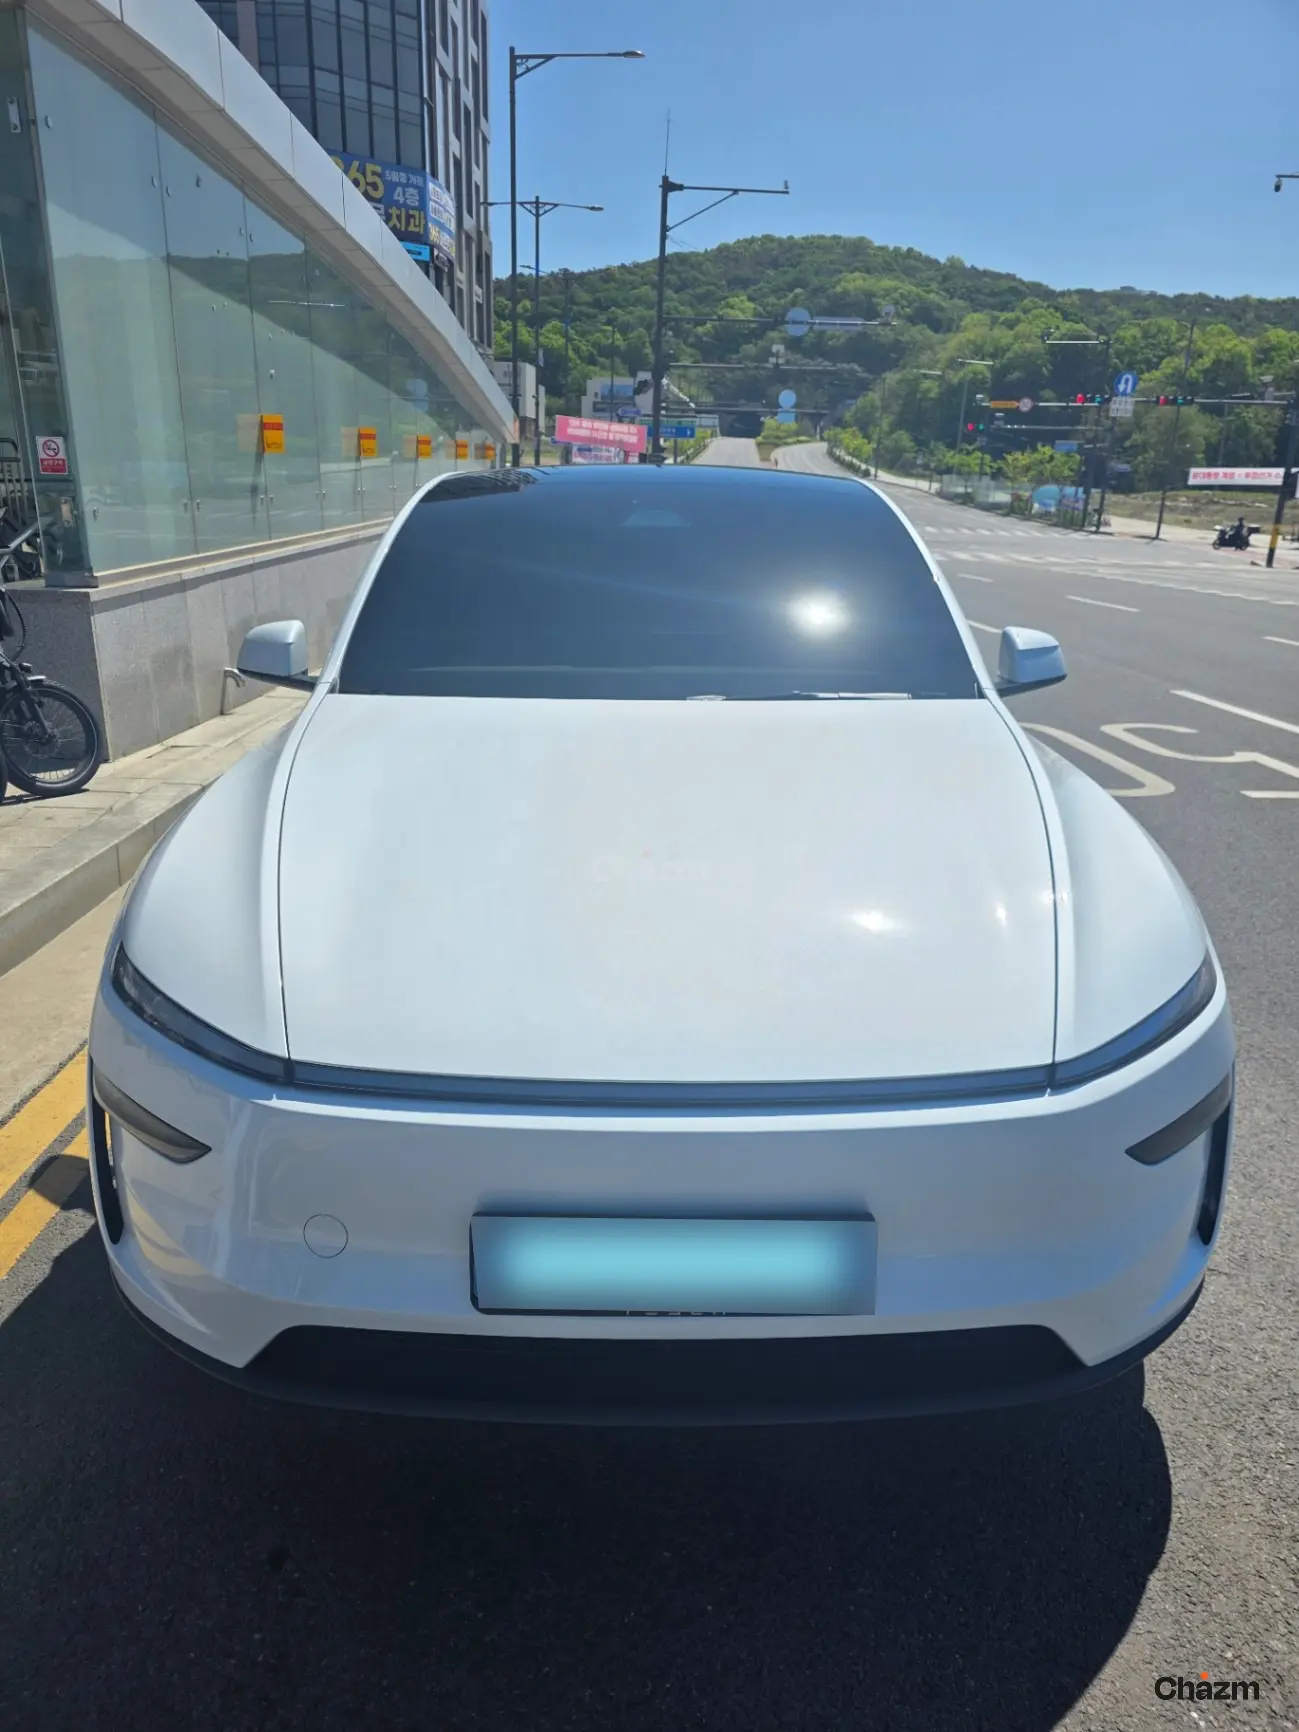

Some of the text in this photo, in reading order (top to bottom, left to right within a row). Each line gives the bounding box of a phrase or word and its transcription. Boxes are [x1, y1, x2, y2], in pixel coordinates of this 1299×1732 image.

[331, 155, 385, 199] 65
[393, 186, 420, 207] 4층
[387, 206, 426, 235] 치과
